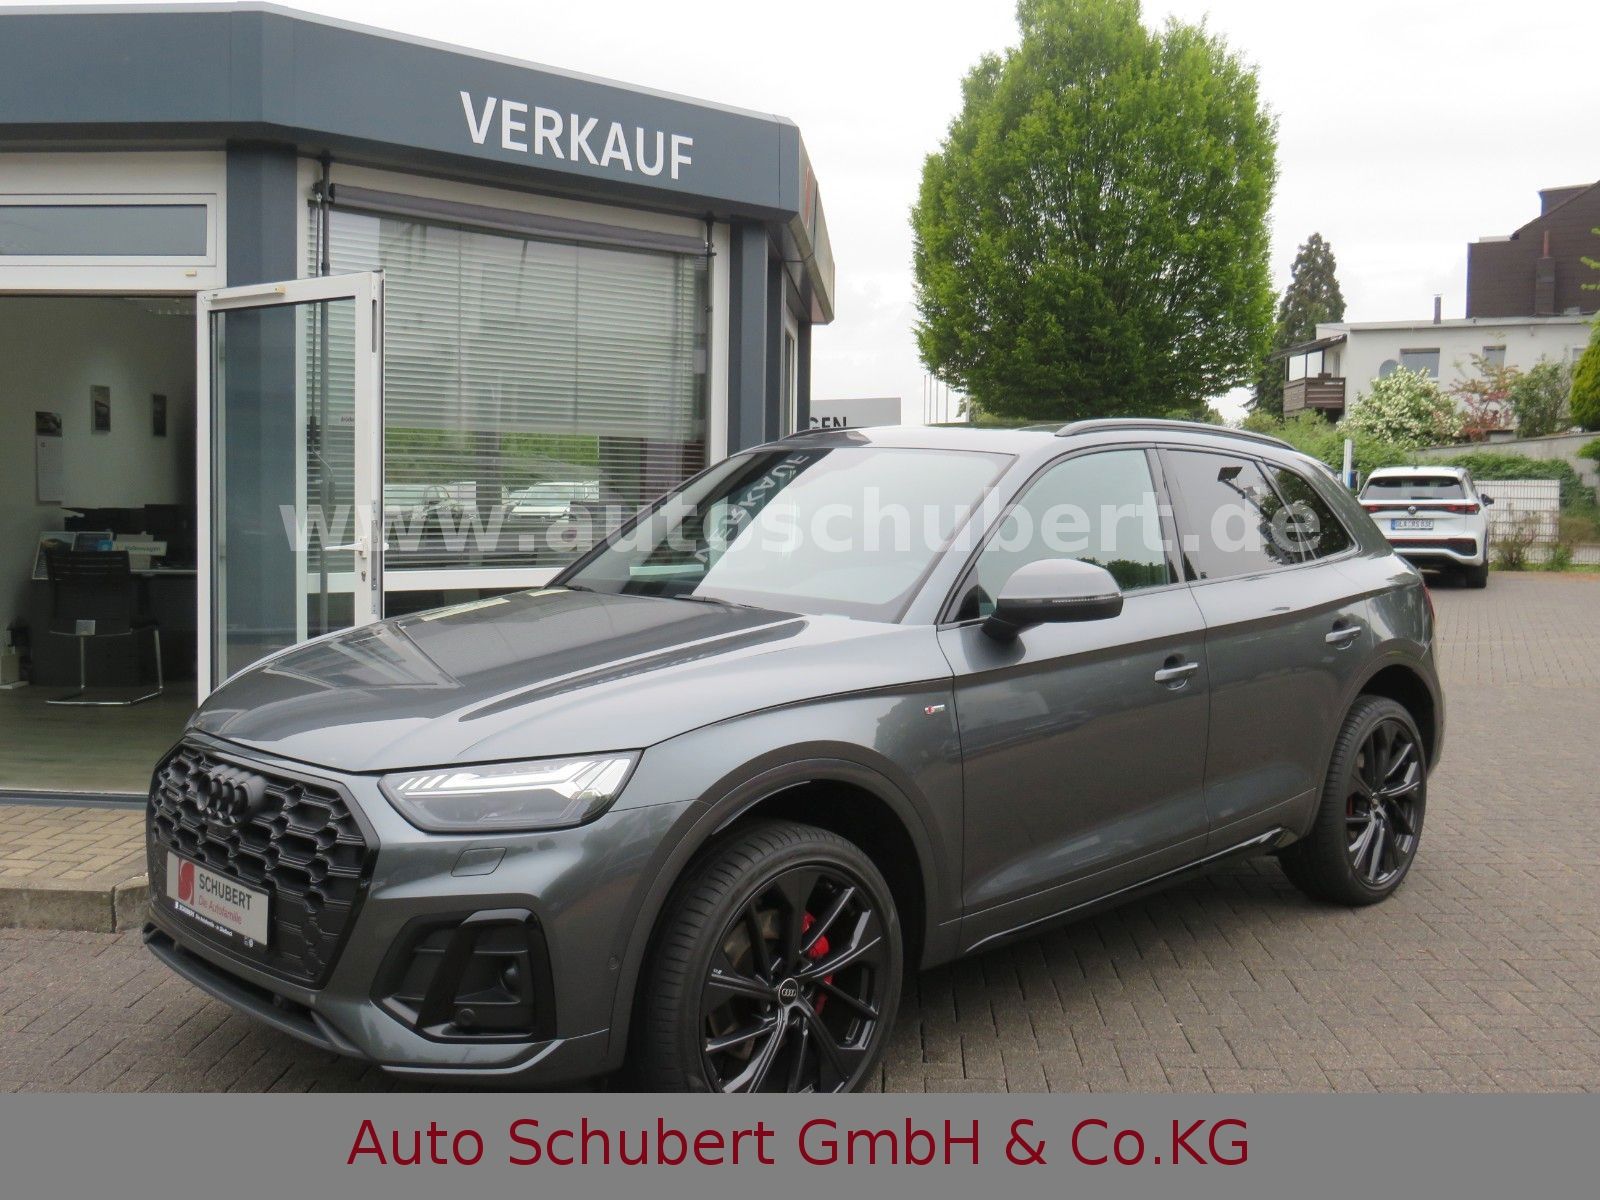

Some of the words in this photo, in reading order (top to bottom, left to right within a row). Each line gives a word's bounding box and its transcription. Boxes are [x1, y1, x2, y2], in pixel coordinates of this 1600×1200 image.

[459, 90, 694, 180] VERKAUF
[809, 416, 847, 429] EN
[199, 873, 252, 910] SCHUBERT
[199, 894, 209, 908] Die
[209, 900, 242, 926] Autofamilie
